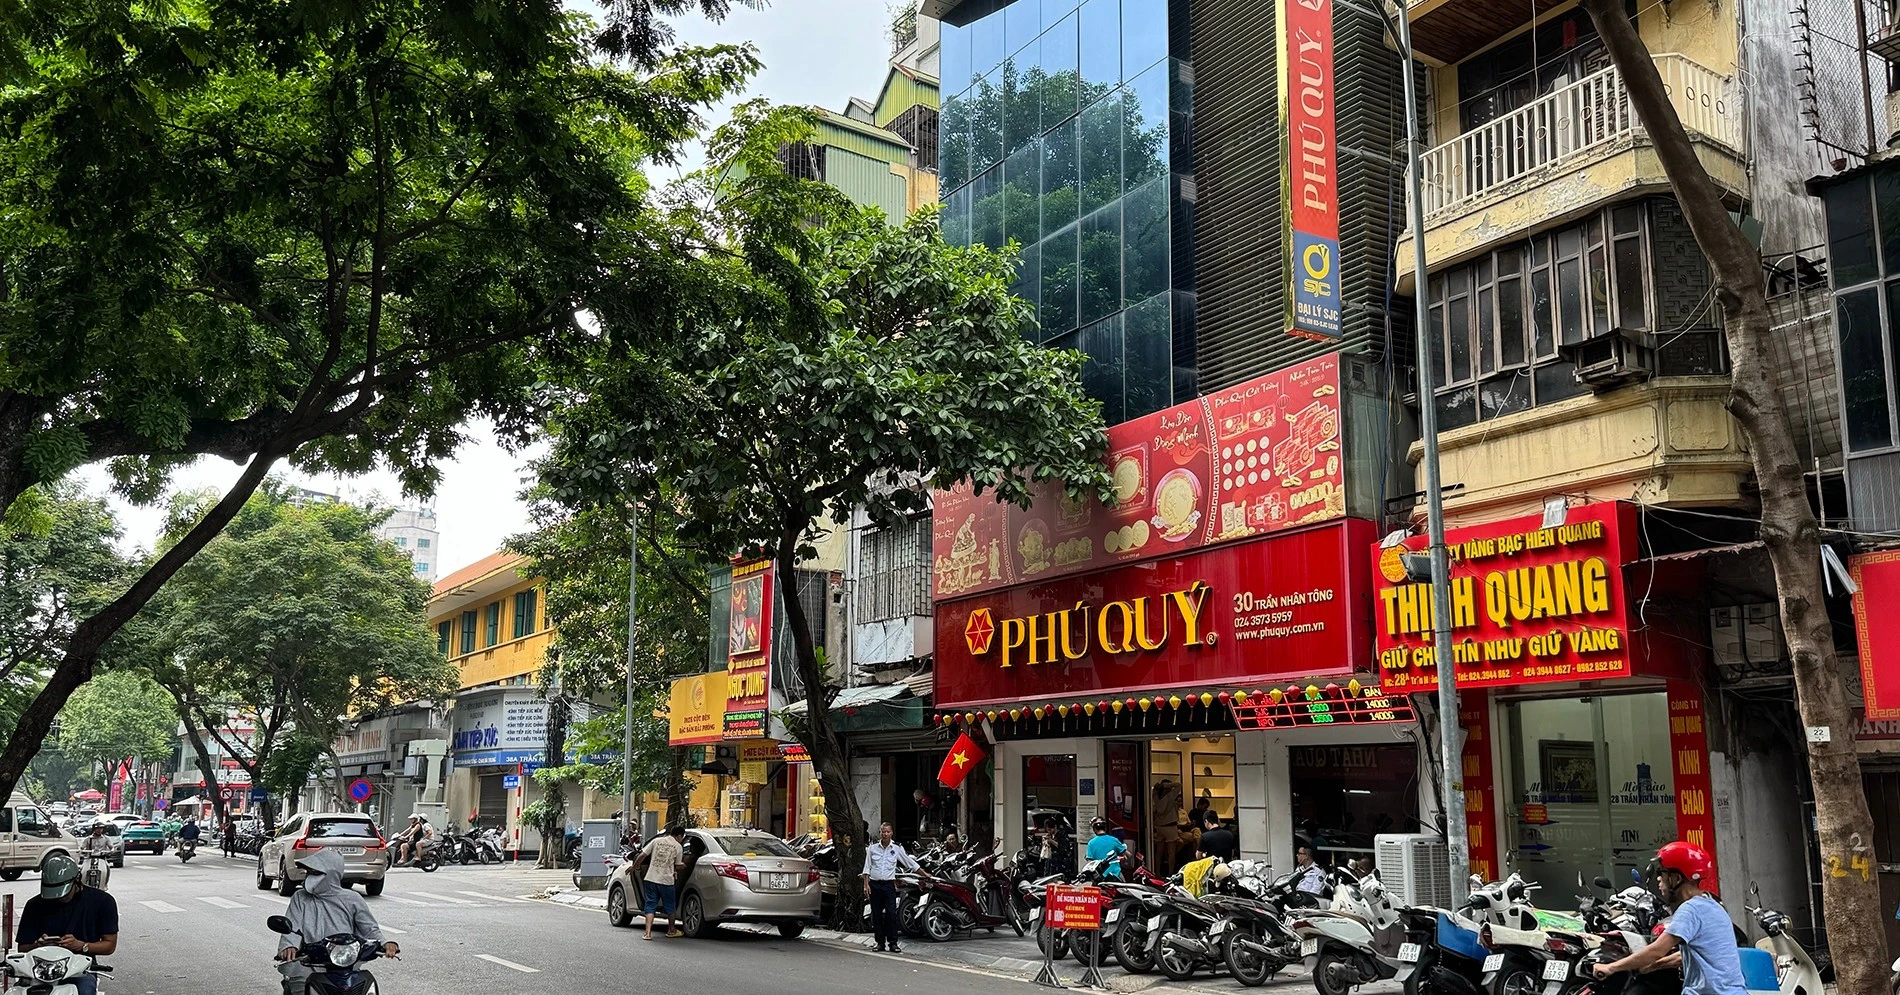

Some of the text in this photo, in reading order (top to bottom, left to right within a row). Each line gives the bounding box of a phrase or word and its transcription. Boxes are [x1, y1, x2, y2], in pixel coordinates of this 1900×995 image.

[1296, 26, 1327, 213] PHÚ QUÝ
[1298, 302, 1338, 322] ĐẠI LÝ SJC
[1464, 539, 1495, 558] VÀNG
[1498, 534, 1522, 556] BẠC
[1558, 520, 1600, 546] QUANG
[1233, 588, 1333, 613] 30 TRẦN NHÂN TÔNG
[1486, 557, 1608, 628] QUANG
[1000, 580, 1212, 668] PHÚ QUÝ
[1234, 611, 1292, 628] 024 3573 5959
[1236, 622, 1324, 640] www.phuquy.com.vn
[1452, 638, 1480, 664] TÍN
[1484, 638, 1522, 660] NHƯ
[1529, 630, 1561, 656] GIỮ
[1569, 626, 1618, 652] VÀNG
[1457, 672, 1468, 682] Tel:
[1469, 670, 1497, 680] 024.3944
[1524, 667, 1534, 677] 024
[1537, 666, 1553, 676] 3944
[1577, 663, 1594, 672] 0982
[1595, 662, 1607, 671] 852
[1609, 660, 1622, 670] 628
[727, 674, 746, 701] NGỌC
[1364, 686, 1382, 697] BÁN
[1254, 708, 1269, 716] SJC
[1671, 699, 1698, 711] CÔNG TY
[484, 723, 498, 747] XÚC
[1671, 716, 1702, 736] THỊNH QUANG
[519, 753, 535, 762] TRẦN
[1464, 753, 1480, 776] KÍNH
[1679, 747, 1700, 775] KÍNH
[1464, 786, 1482, 812] CHÀO
[1611, 795, 1620, 804] 28
[1681, 786, 1704, 815] CHÀO
[1469, 820, 1482, 848] QUÝ
[1850, 832, 1868, 852] 2
